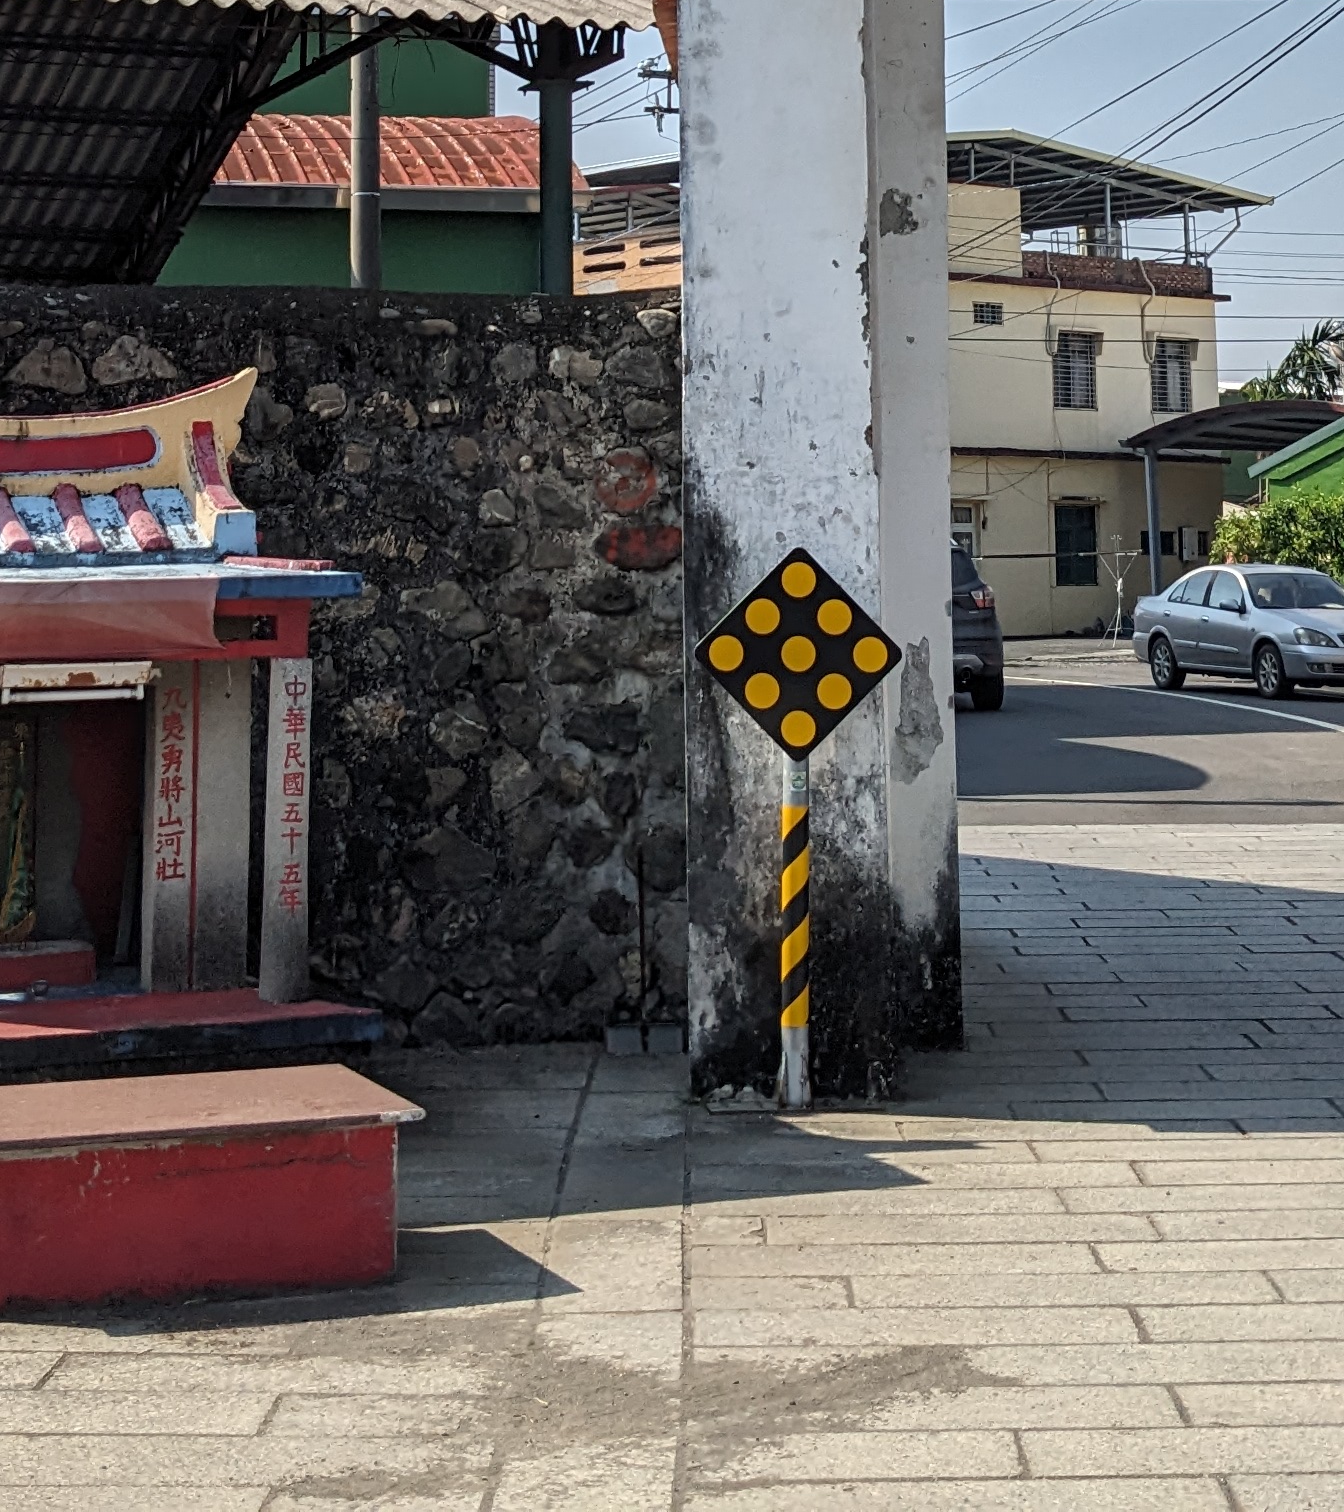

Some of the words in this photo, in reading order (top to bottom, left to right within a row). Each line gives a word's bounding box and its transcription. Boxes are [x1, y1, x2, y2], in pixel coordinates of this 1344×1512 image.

[155, 688, 187, 882] 九夷勇將山河壯
[278, 675, 307, 915] 中華民國五十五年
